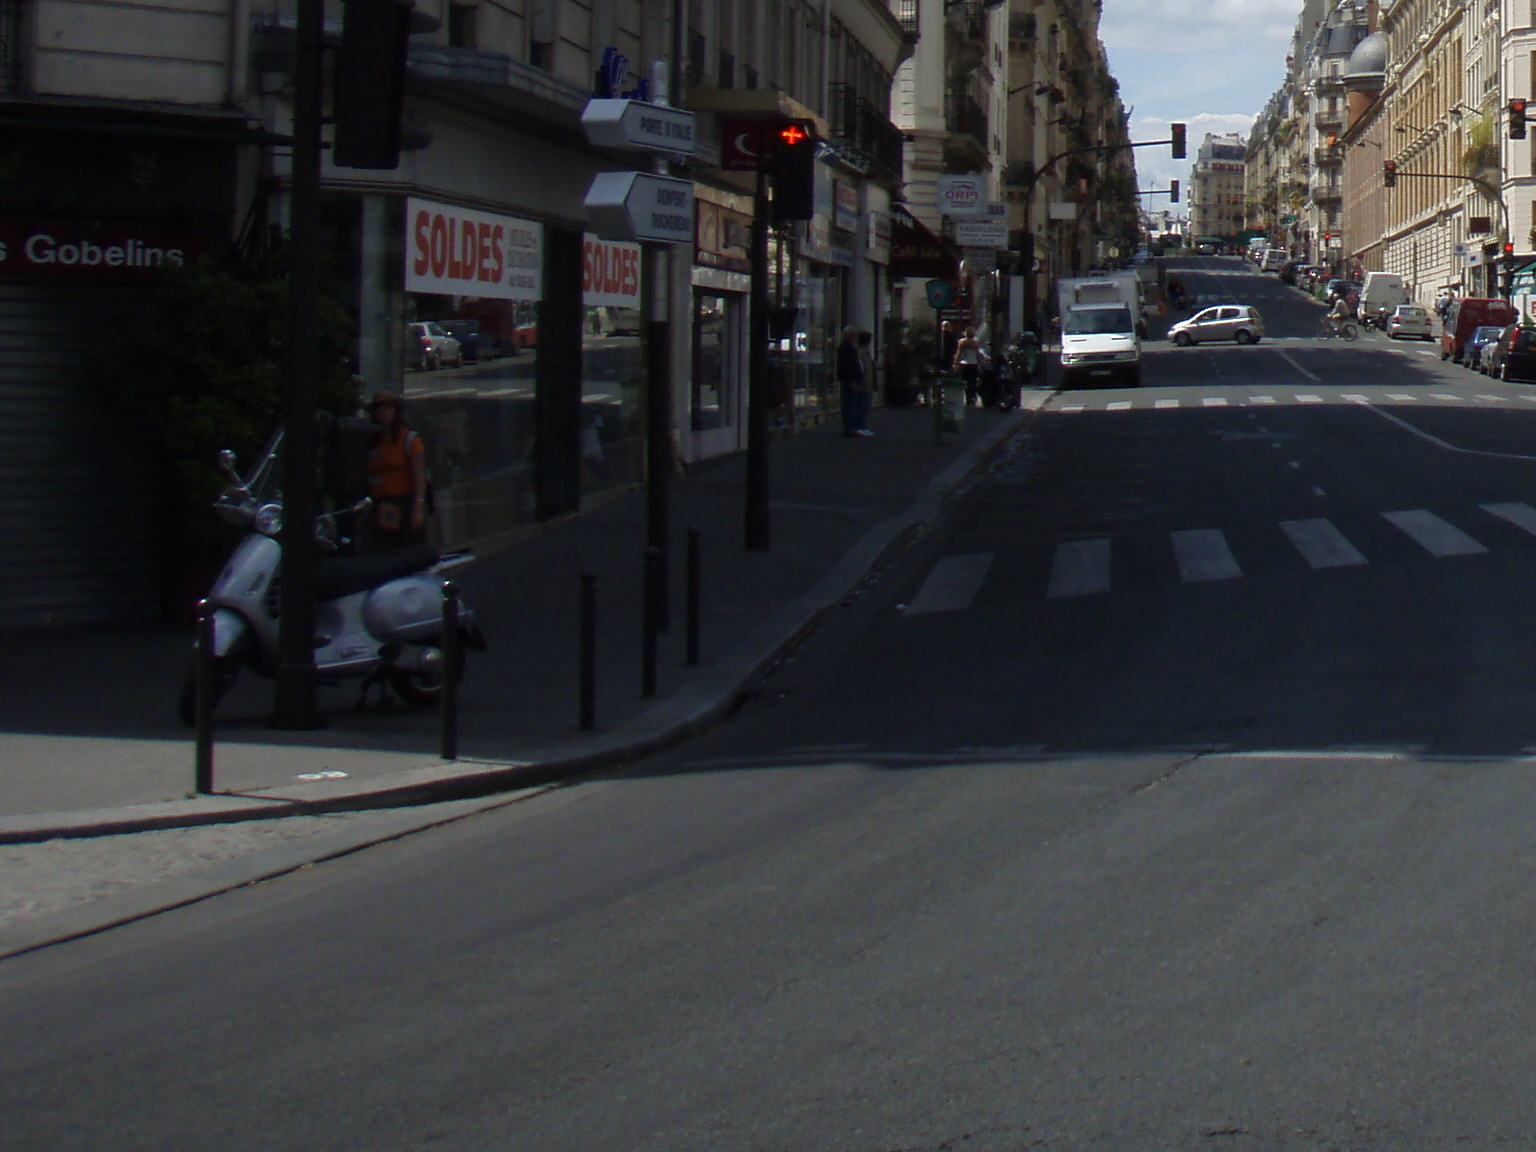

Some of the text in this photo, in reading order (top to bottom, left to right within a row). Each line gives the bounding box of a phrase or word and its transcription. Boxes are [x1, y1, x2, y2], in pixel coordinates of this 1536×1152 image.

[945, 190, 978, 200] ORPI
[25, 232, 186, 267] Gobelins
[414, 210, 504, 285] SOLDES
[583, 240, 638, 297] SOLDES
